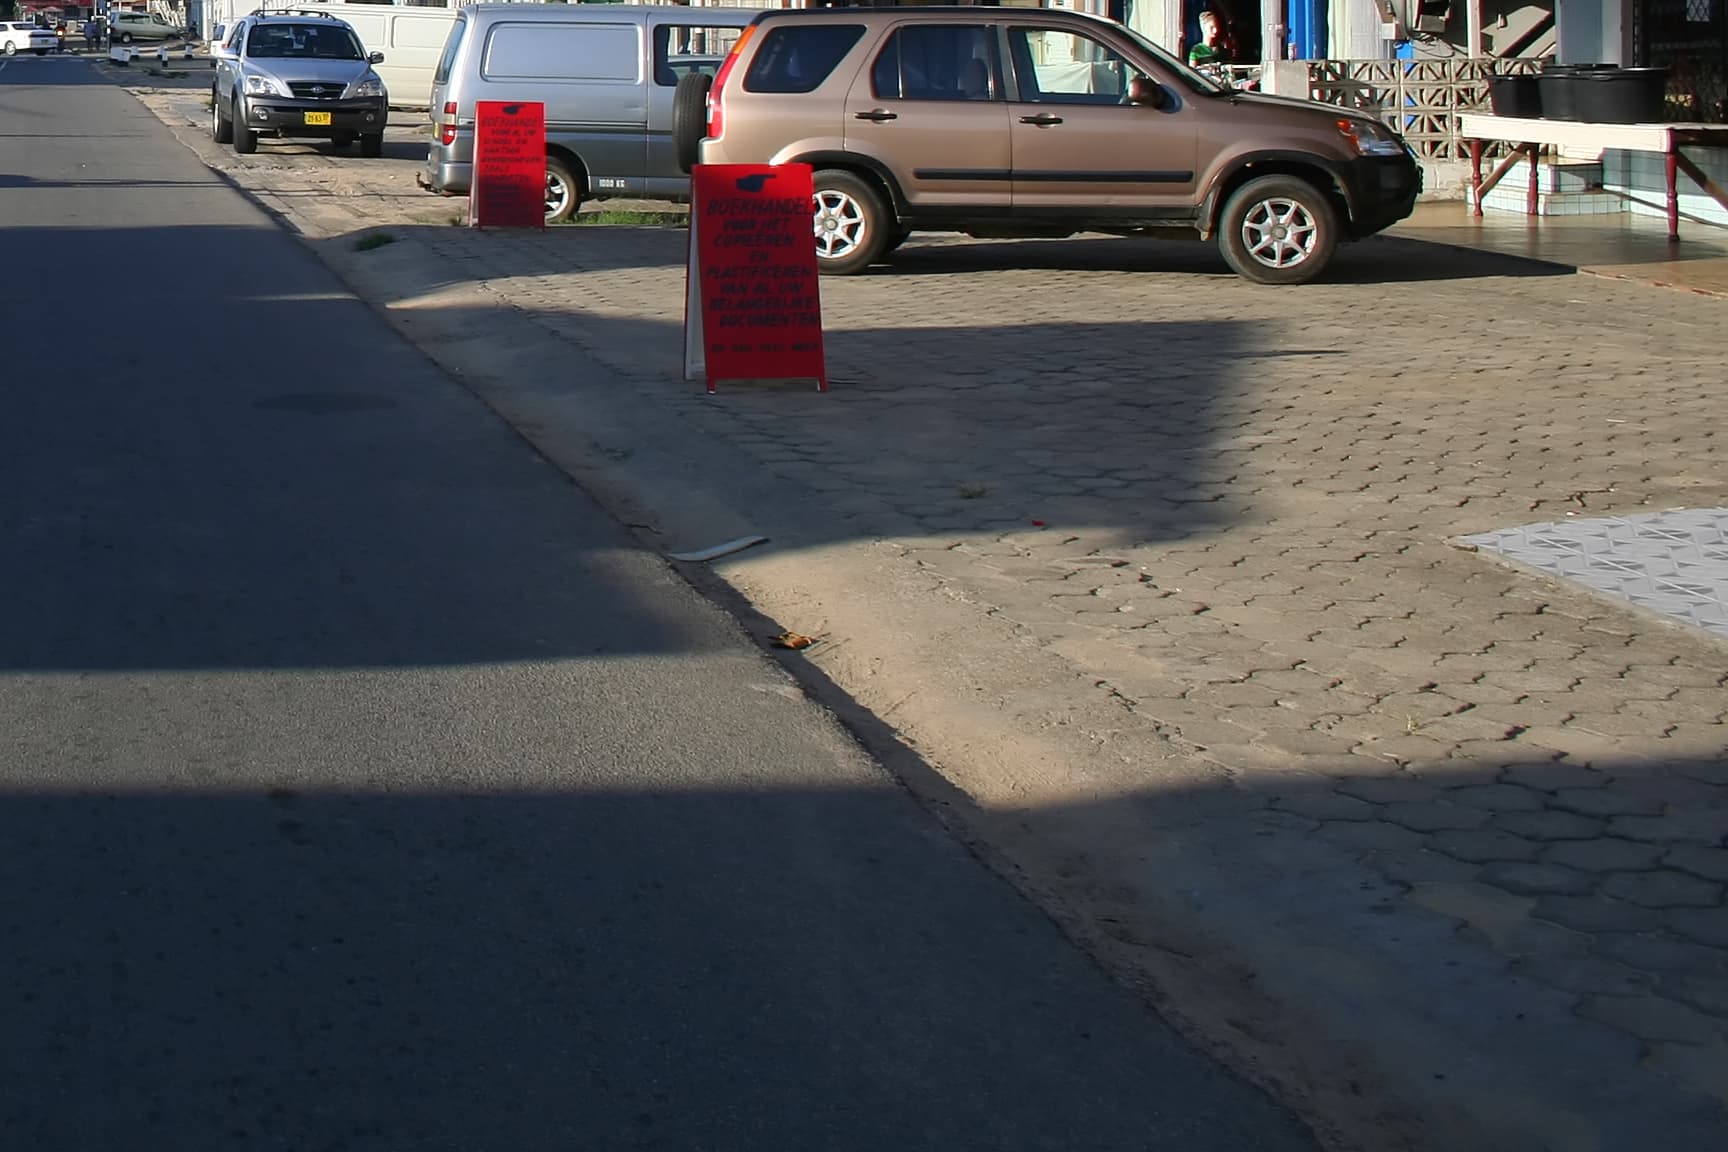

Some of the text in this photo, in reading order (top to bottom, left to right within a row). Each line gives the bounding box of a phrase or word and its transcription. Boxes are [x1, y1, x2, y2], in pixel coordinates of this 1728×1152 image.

[707, 198, 815, 215] BOEKHANDEL
[723, 217, 791, 231] VOOR HET
[748, 250, 769, 262] EN
